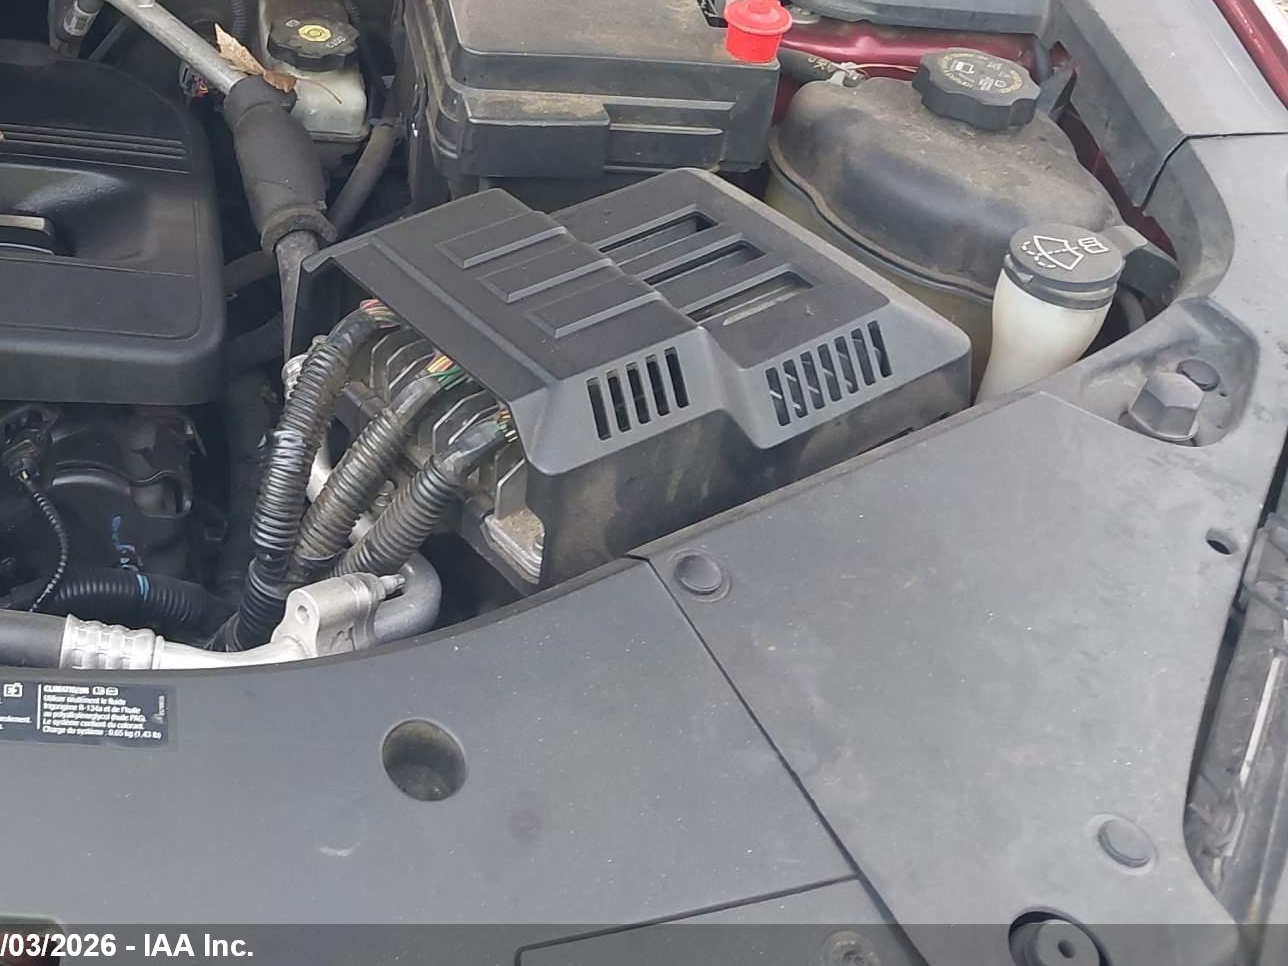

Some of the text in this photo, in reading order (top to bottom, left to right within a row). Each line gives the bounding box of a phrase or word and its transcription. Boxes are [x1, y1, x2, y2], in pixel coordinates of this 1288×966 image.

[78, 704, 103, 712] R-134a
[42, 726, 66, 735] Charge
[124, 730, 134, 738] kg
